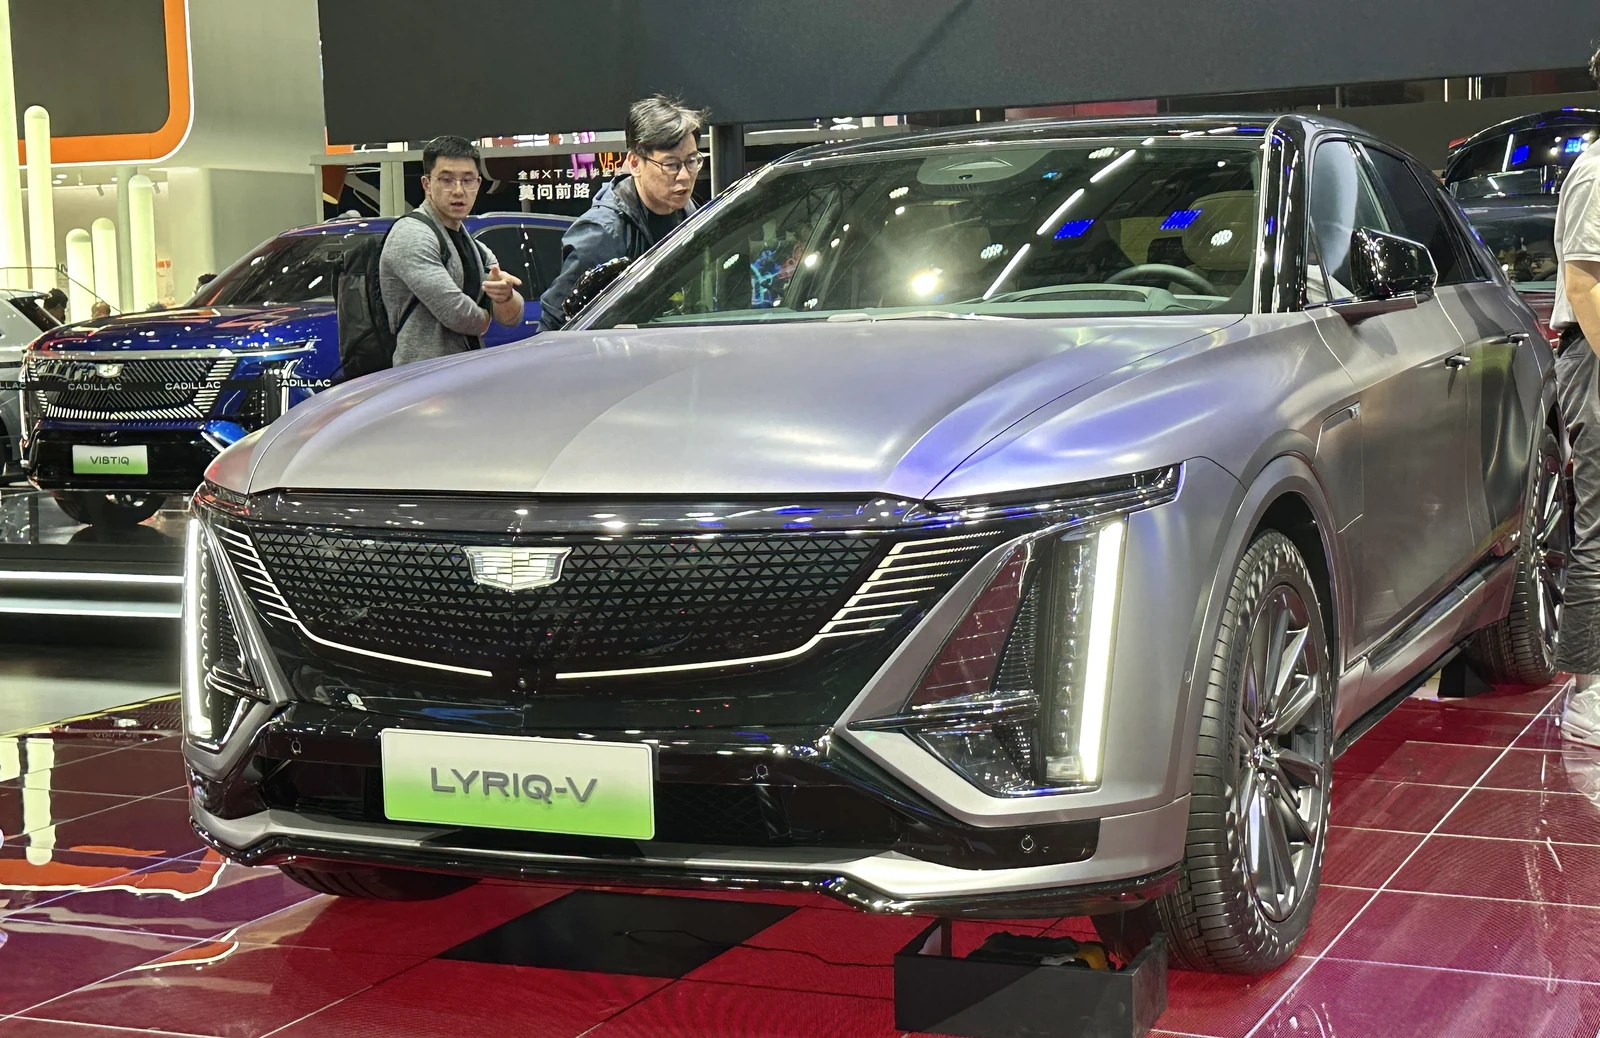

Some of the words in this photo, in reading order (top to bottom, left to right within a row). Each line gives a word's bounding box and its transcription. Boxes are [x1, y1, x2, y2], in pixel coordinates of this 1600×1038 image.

[518, 183, 590, 200] 莫问前路
[67, 383, 122, 391] CADILLAC
[164, 381, 221, 391] CADILLAC
[430, 767, 598, 804] LYRIQ-V
